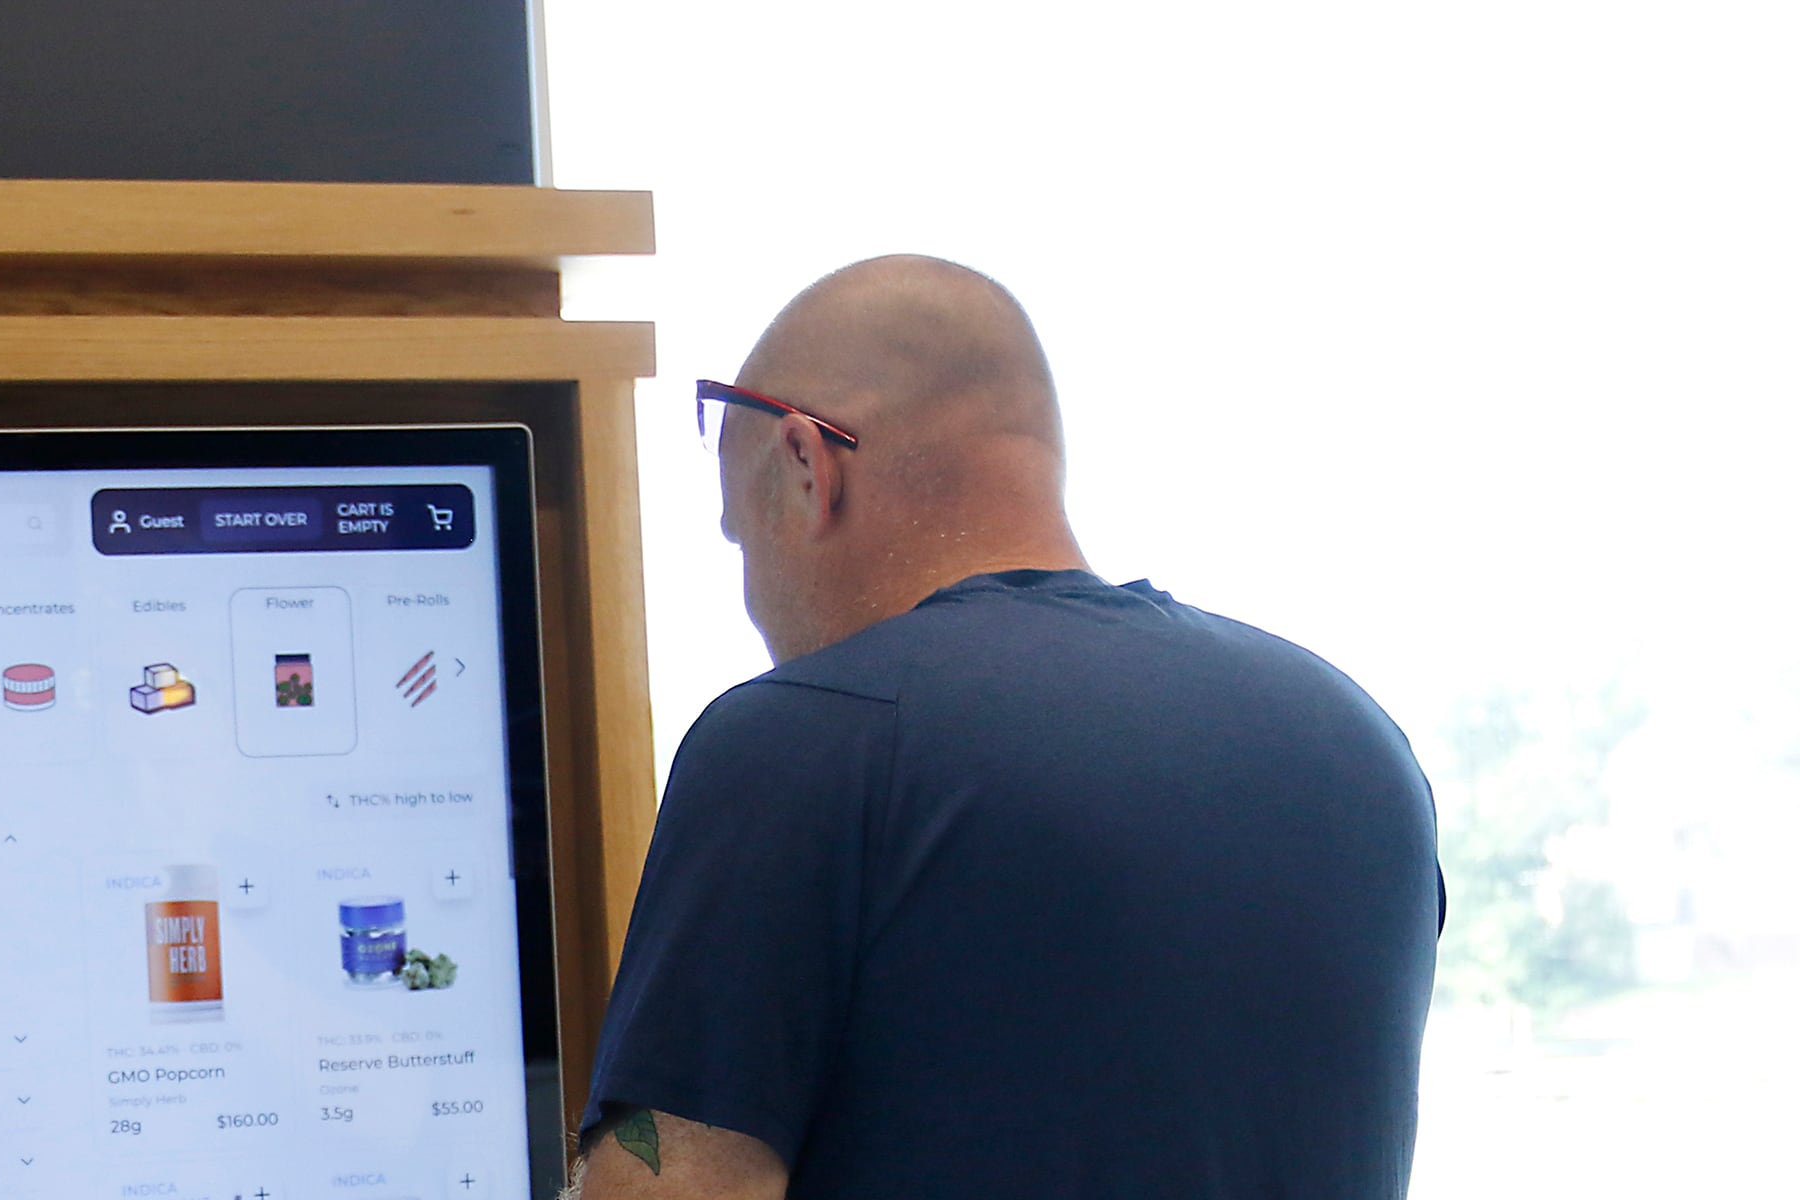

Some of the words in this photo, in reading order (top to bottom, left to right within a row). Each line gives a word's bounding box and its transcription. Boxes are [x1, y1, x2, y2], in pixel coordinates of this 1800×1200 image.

[337, 504, 374, 518] CART
[378, 503, 394, 517] IS
[140, 514, 185, 529] Guest
[215, 513, 262, 528] START
[265, 512, 308, 527] OVER
[338, 519, 389, 534] EMPTY
[132, 599, 187, 613] Edibles
[265, 596, 314, 610] Flower
[387, 594, 450, 607] Pre-Rolls
[395, 792, 427, 808] high
[431, 793, 446, 805] to
[449, 791, 474, 804] low
[316, 868, 371, 881] INDICA
[106, 876, 162, 889] INDICA
[156, 917, 205, 944] SIMPLY
[170, 947, 206, 974] HERB
[319, 1055, 383, 1072] Reserve
[388, 1050, 476, 1069] Butterstuff
[108, 1069, 151, 1084] GMO
[156, 1065, 226, 1084] Popcorn
[320, 1083, 359, 1095] Ozone
[109, 1096, 152, 1110] Simply
[156, 1093, 187, 1105] Herb
[432, 1100, 484, 1116] $55.00
[217, 1112, 279, 1129] $160.00
[320, 1106, 354, 1122] 3.5g
[111, 1119, 142, 1135] 28g
[332, 1173, 386, 1188] INDICA
[122, 1182, 177, 1197] INDICA
